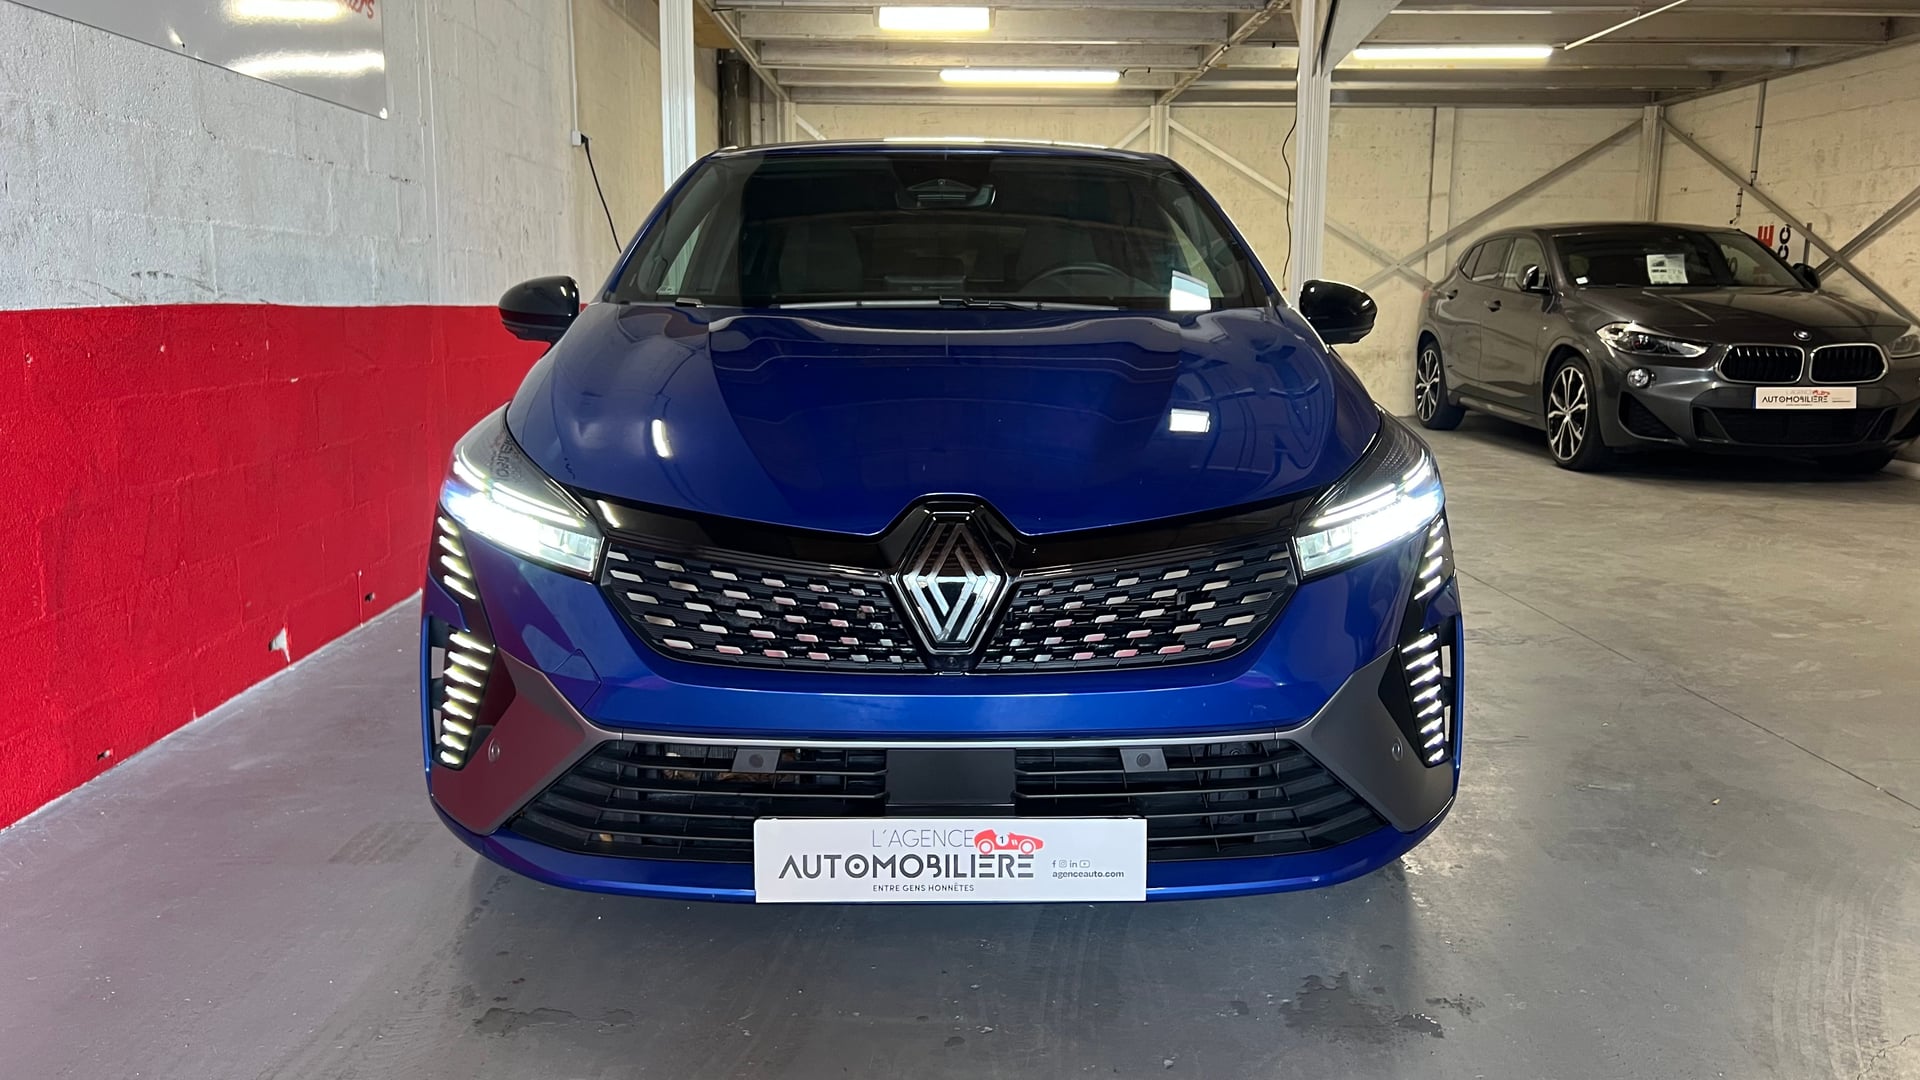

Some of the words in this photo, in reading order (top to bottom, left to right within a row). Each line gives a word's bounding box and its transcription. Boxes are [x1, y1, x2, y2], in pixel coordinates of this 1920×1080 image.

[1052, 870, 1125, 880] agenceauto.com
[872, 884, 900, 892] ENTRE
[902, 884, 926, 892] GENS
[928, 882, 975, 892] HONNÊTES
